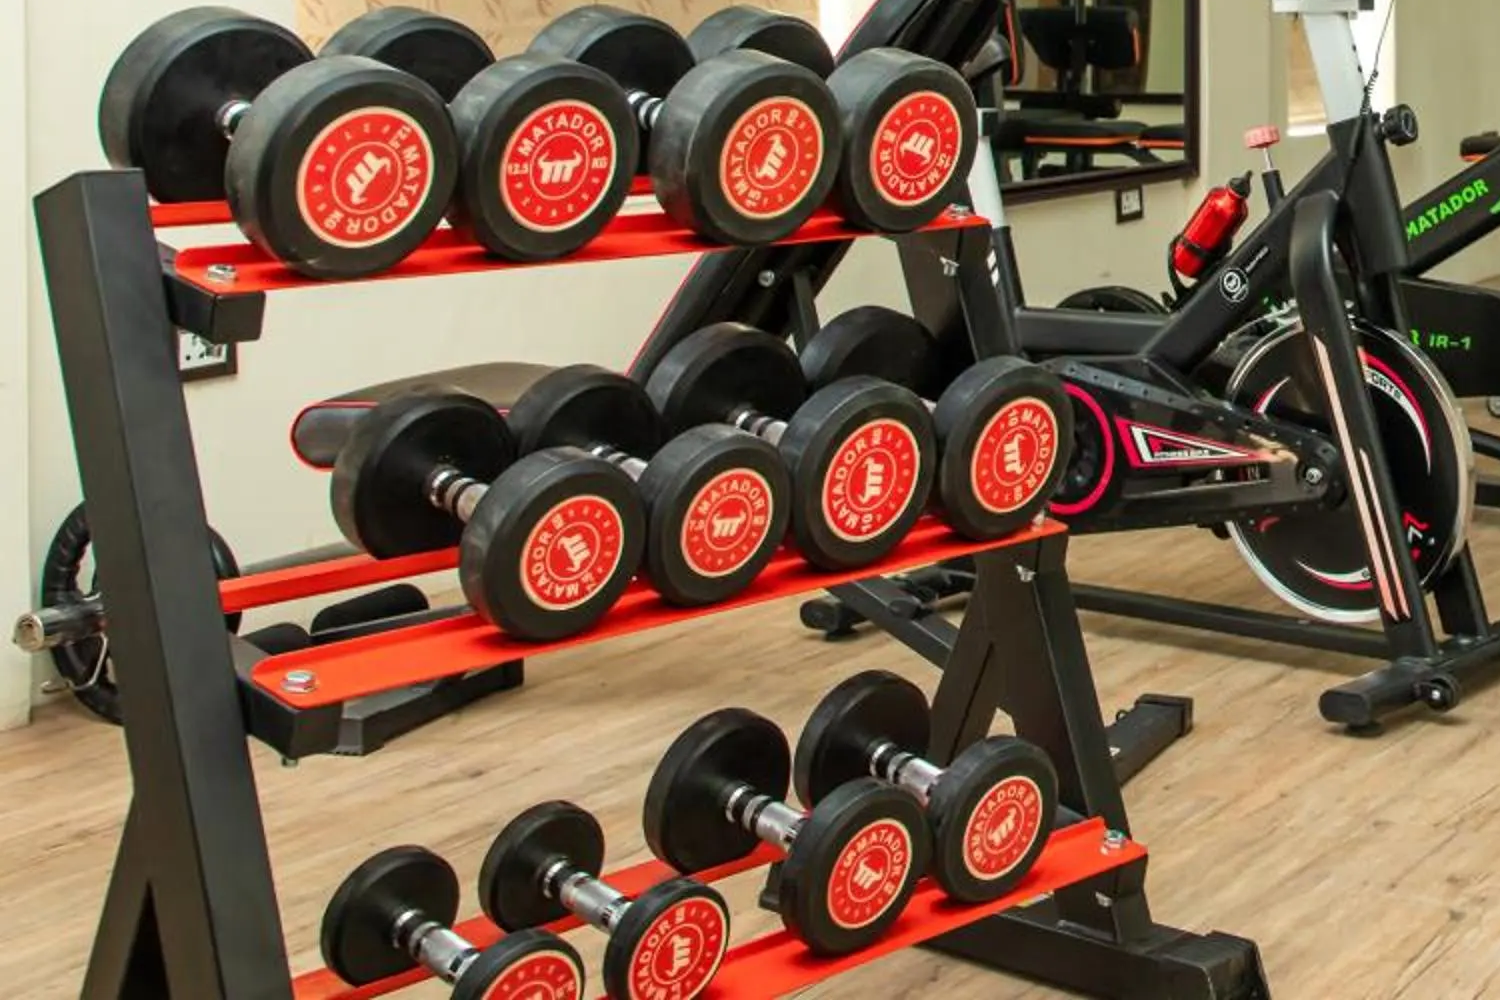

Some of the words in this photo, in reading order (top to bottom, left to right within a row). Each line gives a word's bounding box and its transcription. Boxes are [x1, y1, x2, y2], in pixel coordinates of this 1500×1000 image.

[517, 112, 604, 157] MATADOR
[730, 108, 782, 196] MATADOR
[346, 144, 421, 235] MATADOR
[880, 147, 941, 197] MATADOR
[324, 210, 344, 230] KG
[1406, 179, 1489, 242] MATADOR
[1429, 334, 1471, 350] IR-1
[1022, 408, 1050, 489] MATADOR
[698, 479, 766, 515] MATADOR
[832, 437, 868, 529] MATADOR
[531, 531, 579, 599] MATADOR
[856, 828, 905, 878] MATADOR
